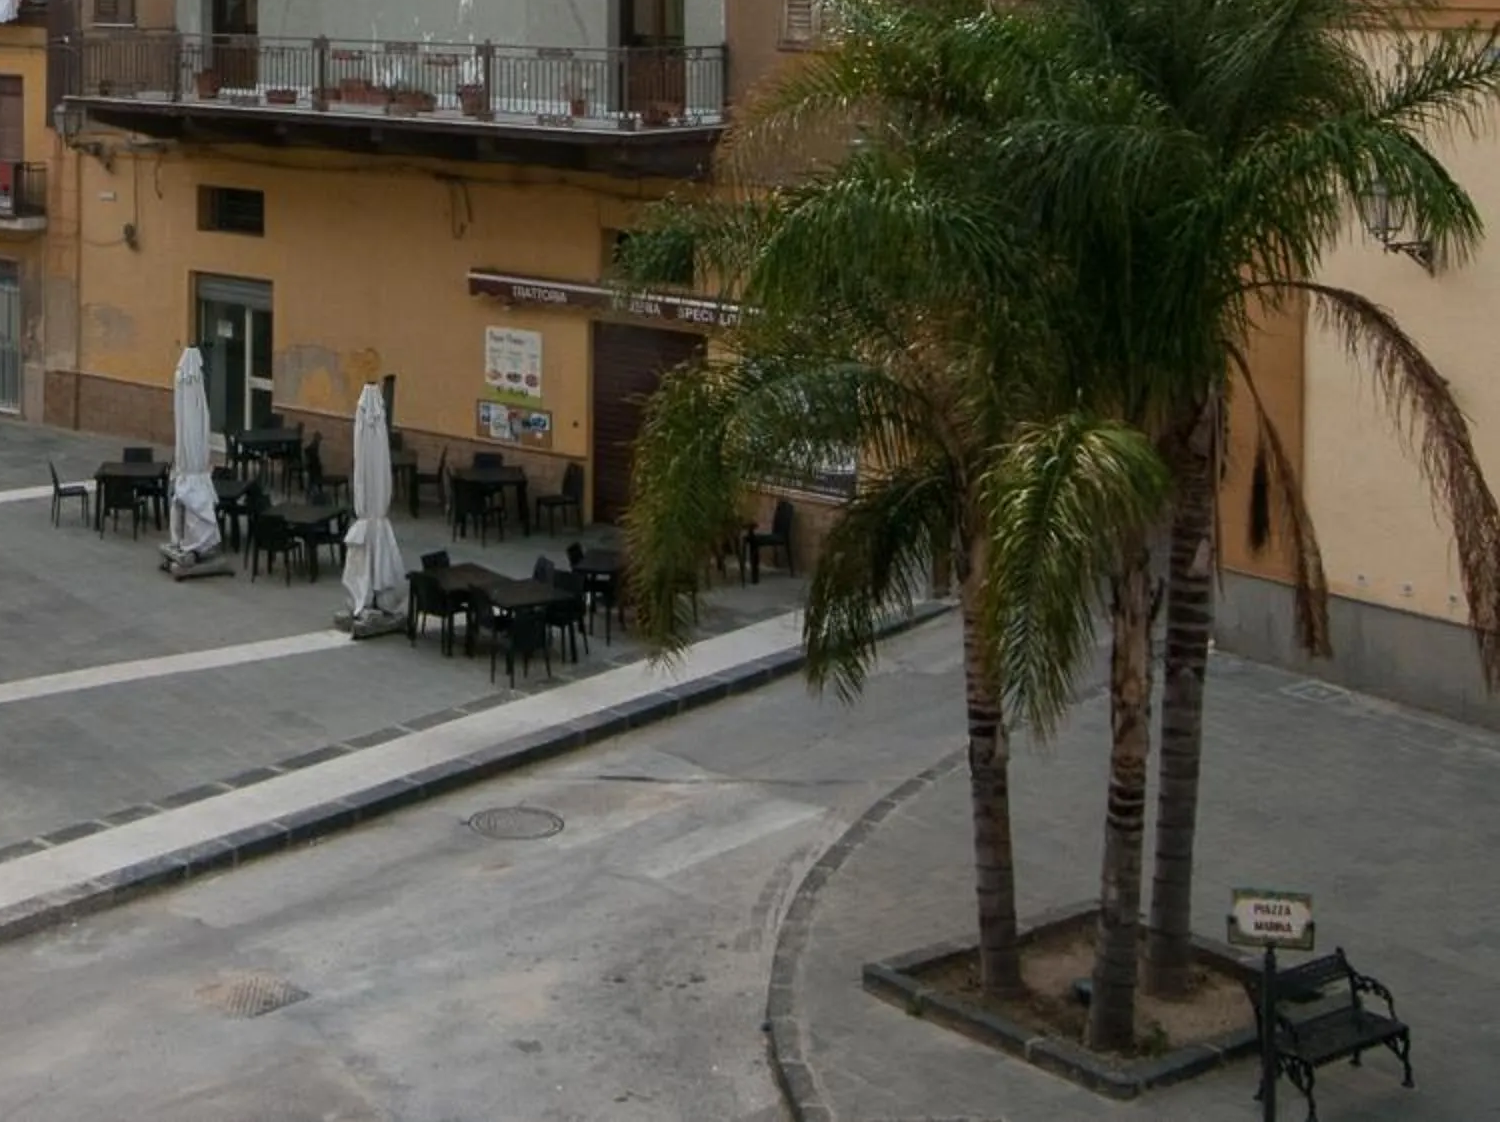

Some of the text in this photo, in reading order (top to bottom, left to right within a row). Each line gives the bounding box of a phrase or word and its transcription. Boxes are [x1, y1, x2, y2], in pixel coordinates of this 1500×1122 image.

[512, 285, 568, 303] TRATTORIA
[1253, 903, 1292, 916] PIAZZA
[1253, 921, 1293, 932] MARINA
